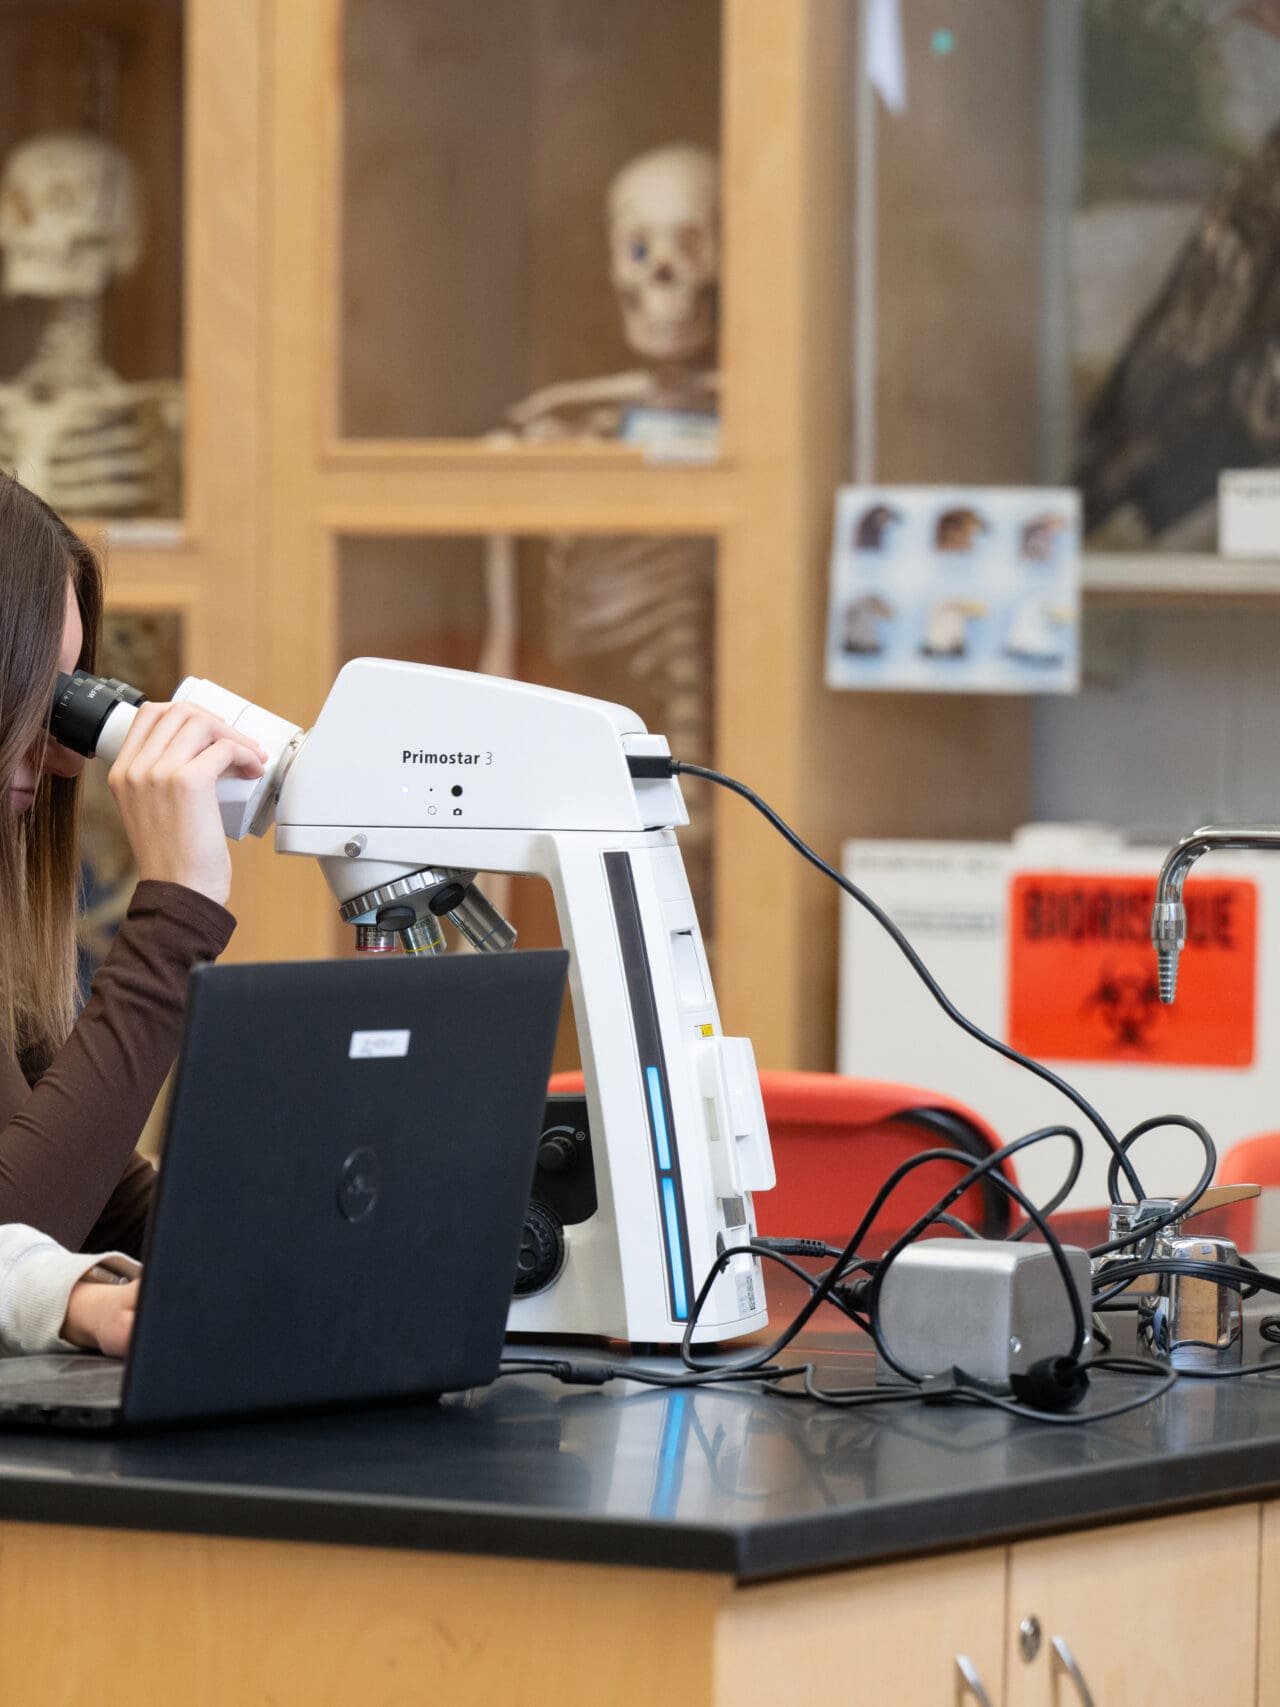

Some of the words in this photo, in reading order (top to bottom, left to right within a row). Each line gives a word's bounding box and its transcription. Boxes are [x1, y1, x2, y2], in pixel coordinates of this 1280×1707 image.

[402, 750, 481, 765] Primostar
[484, 751, 493, 766] 3
[1024, 888, 1232, 949] BIORISUE
